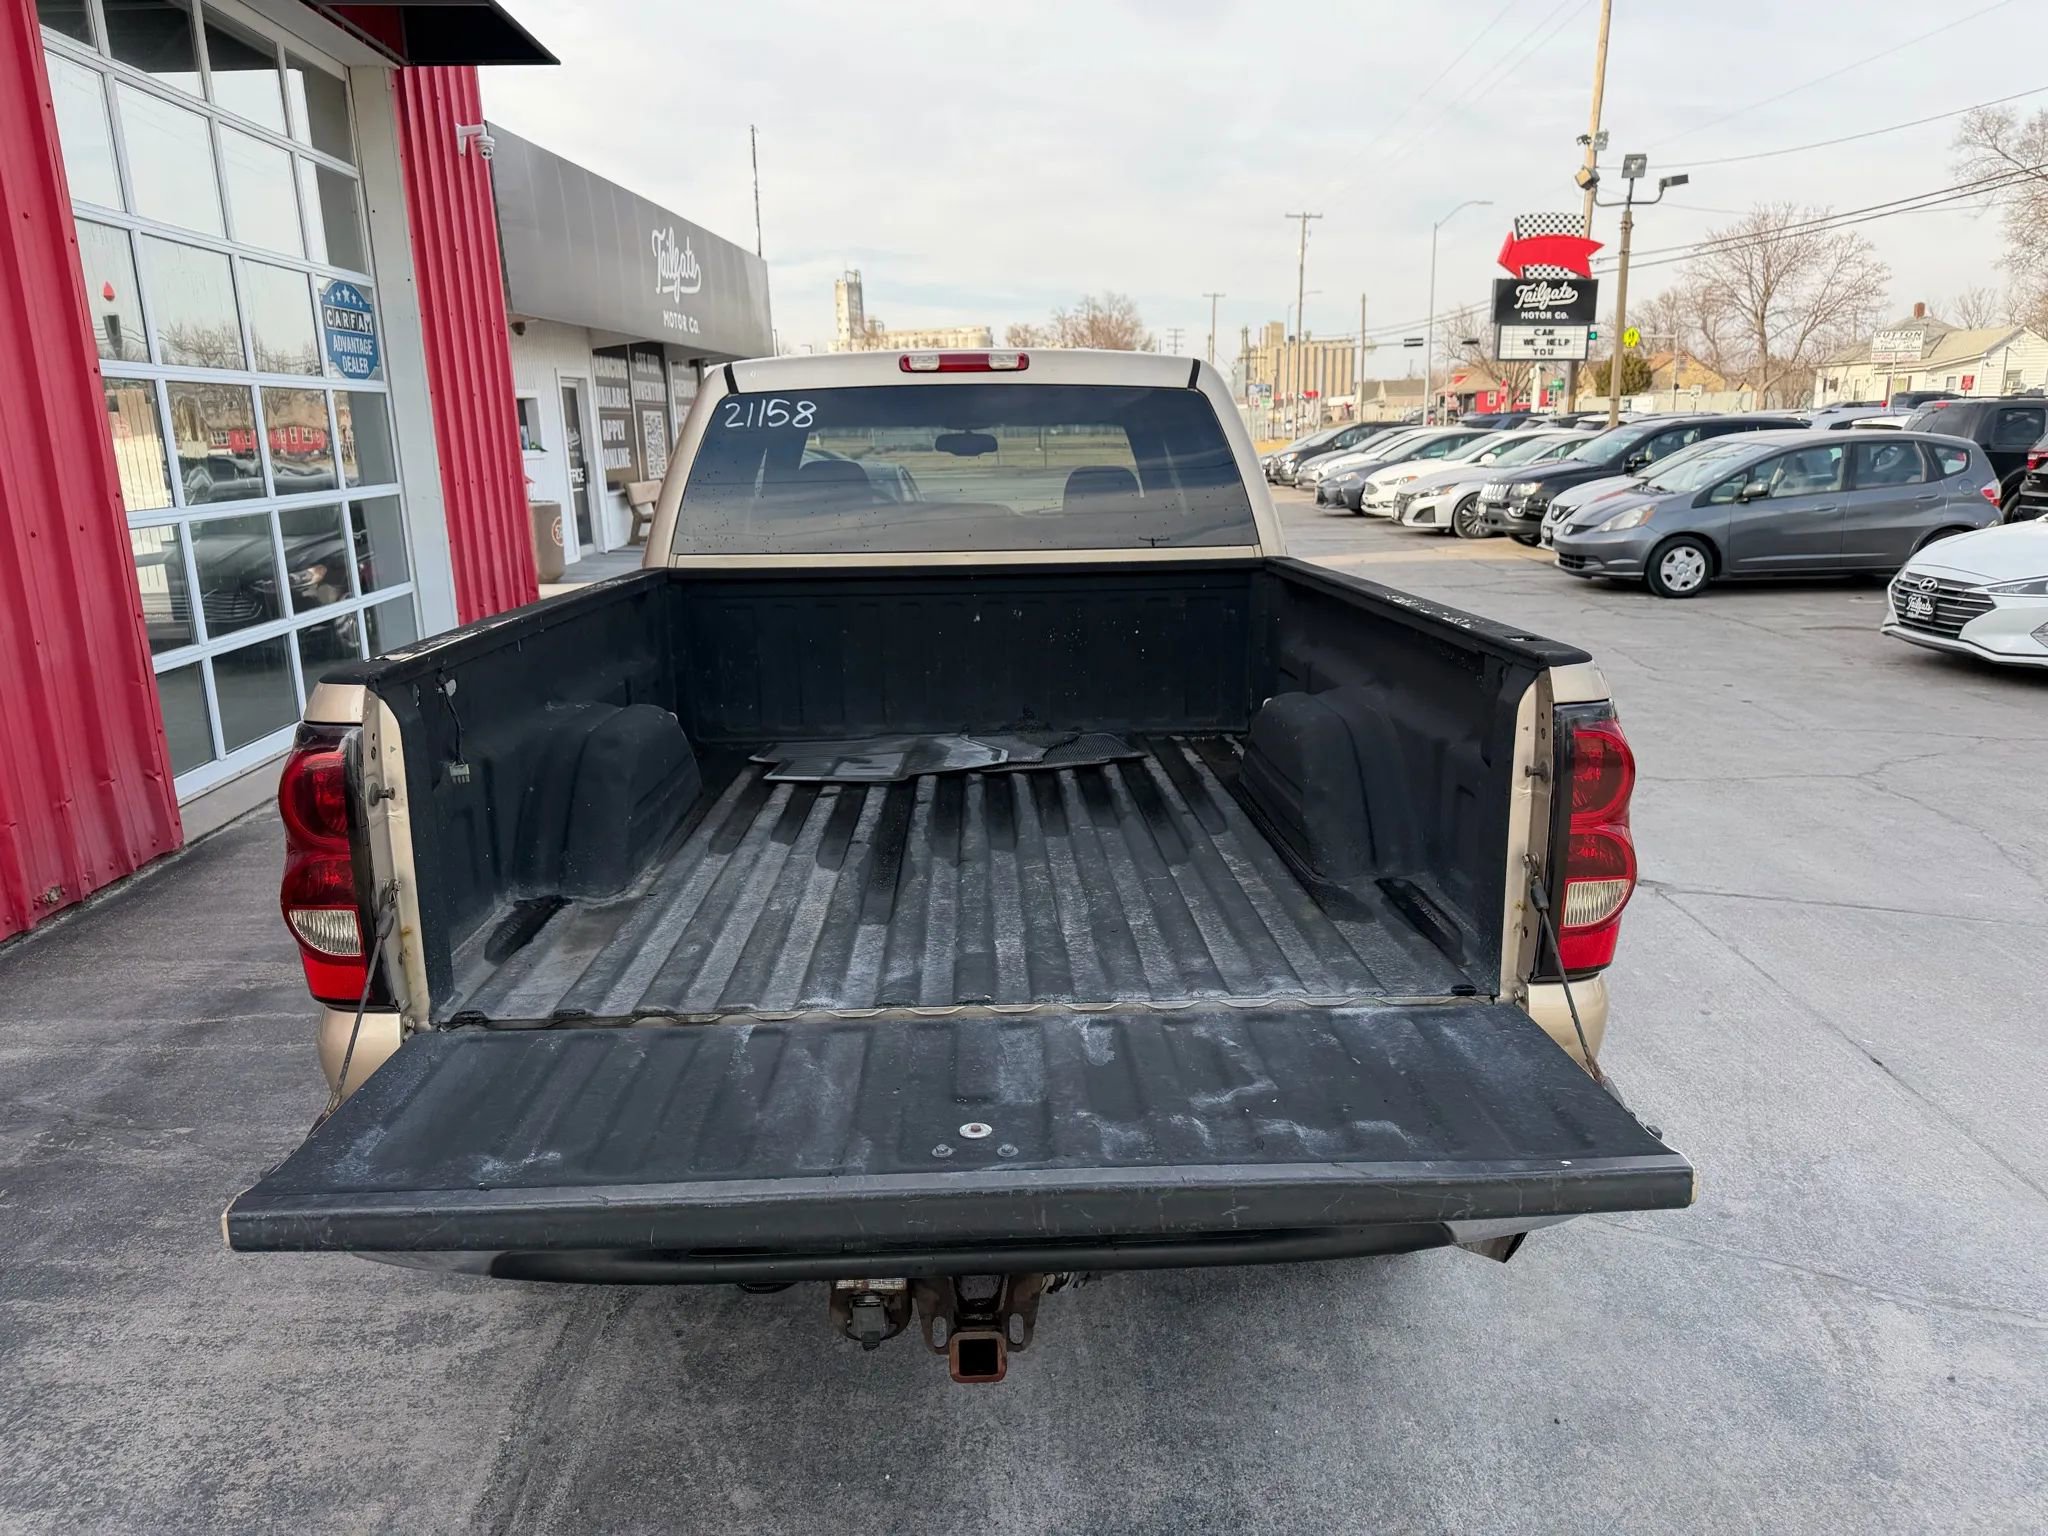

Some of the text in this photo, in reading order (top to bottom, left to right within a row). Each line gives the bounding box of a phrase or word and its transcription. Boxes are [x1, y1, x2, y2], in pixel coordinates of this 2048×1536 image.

[652, 226, 702, 304] Tailgate
[1514, 281, 1579, 310] Tailgate
[326, 308, 373, 334] CARFAX
[663, 309, 701, 334] MOTOR CO.
[1521, 311, 1569, 320] MOTOR CO.
[1523, 338, 1570, 347] WE HELP
[1534, 328, 1555, 337] CAN
[333, 334, 373, 356] ADVANTAGE
[341, 354, 369, 374] DEALER
[725, 399, 817, 428] 21158
[602, 419, 626, 441] APPLY
[603, 447, 632, 471] ONLINE
